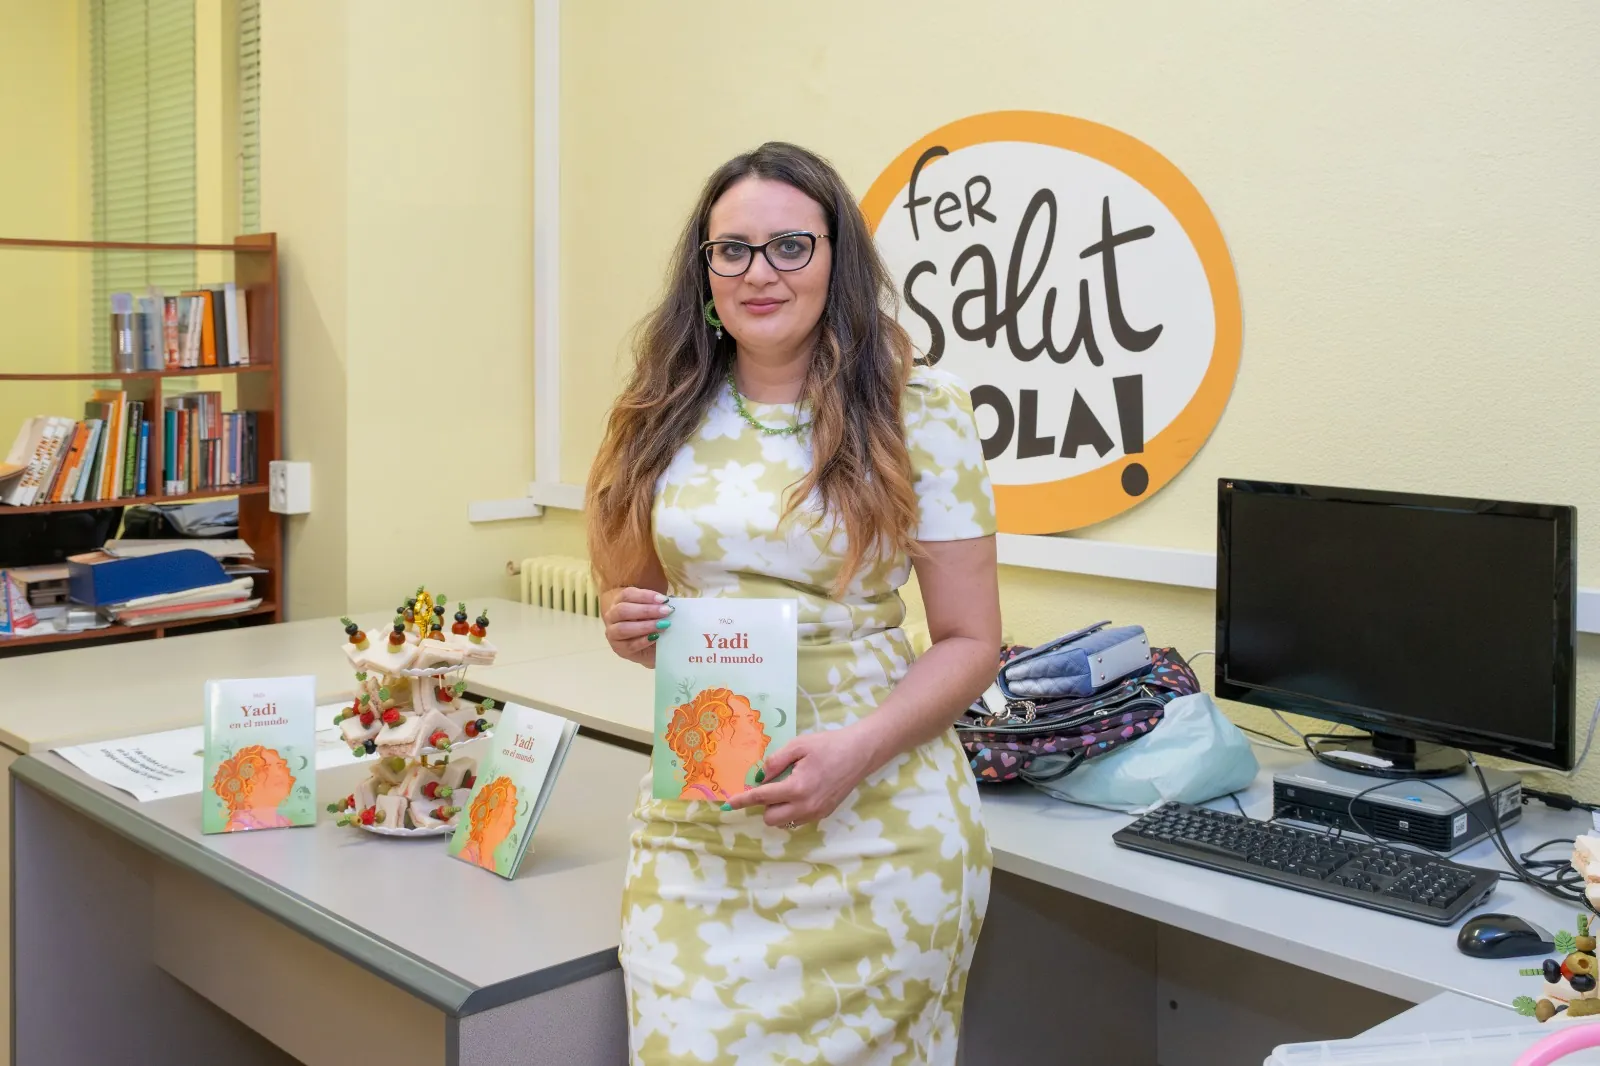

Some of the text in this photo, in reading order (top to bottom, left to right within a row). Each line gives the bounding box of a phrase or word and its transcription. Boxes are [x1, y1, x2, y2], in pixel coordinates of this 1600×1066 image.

[903, 188, 1164, 367] salut
[702, 633, 748, 649] Yadi
[688, 653, 763, 664] en el mundo
[240, 703, 277, 717] Yadi
[243, 719, 252, 728] el
[254, 717, 289, 727] mundo
[514, 734, 535, 750] Yadi
[515, 753, 534, 763] mundo
